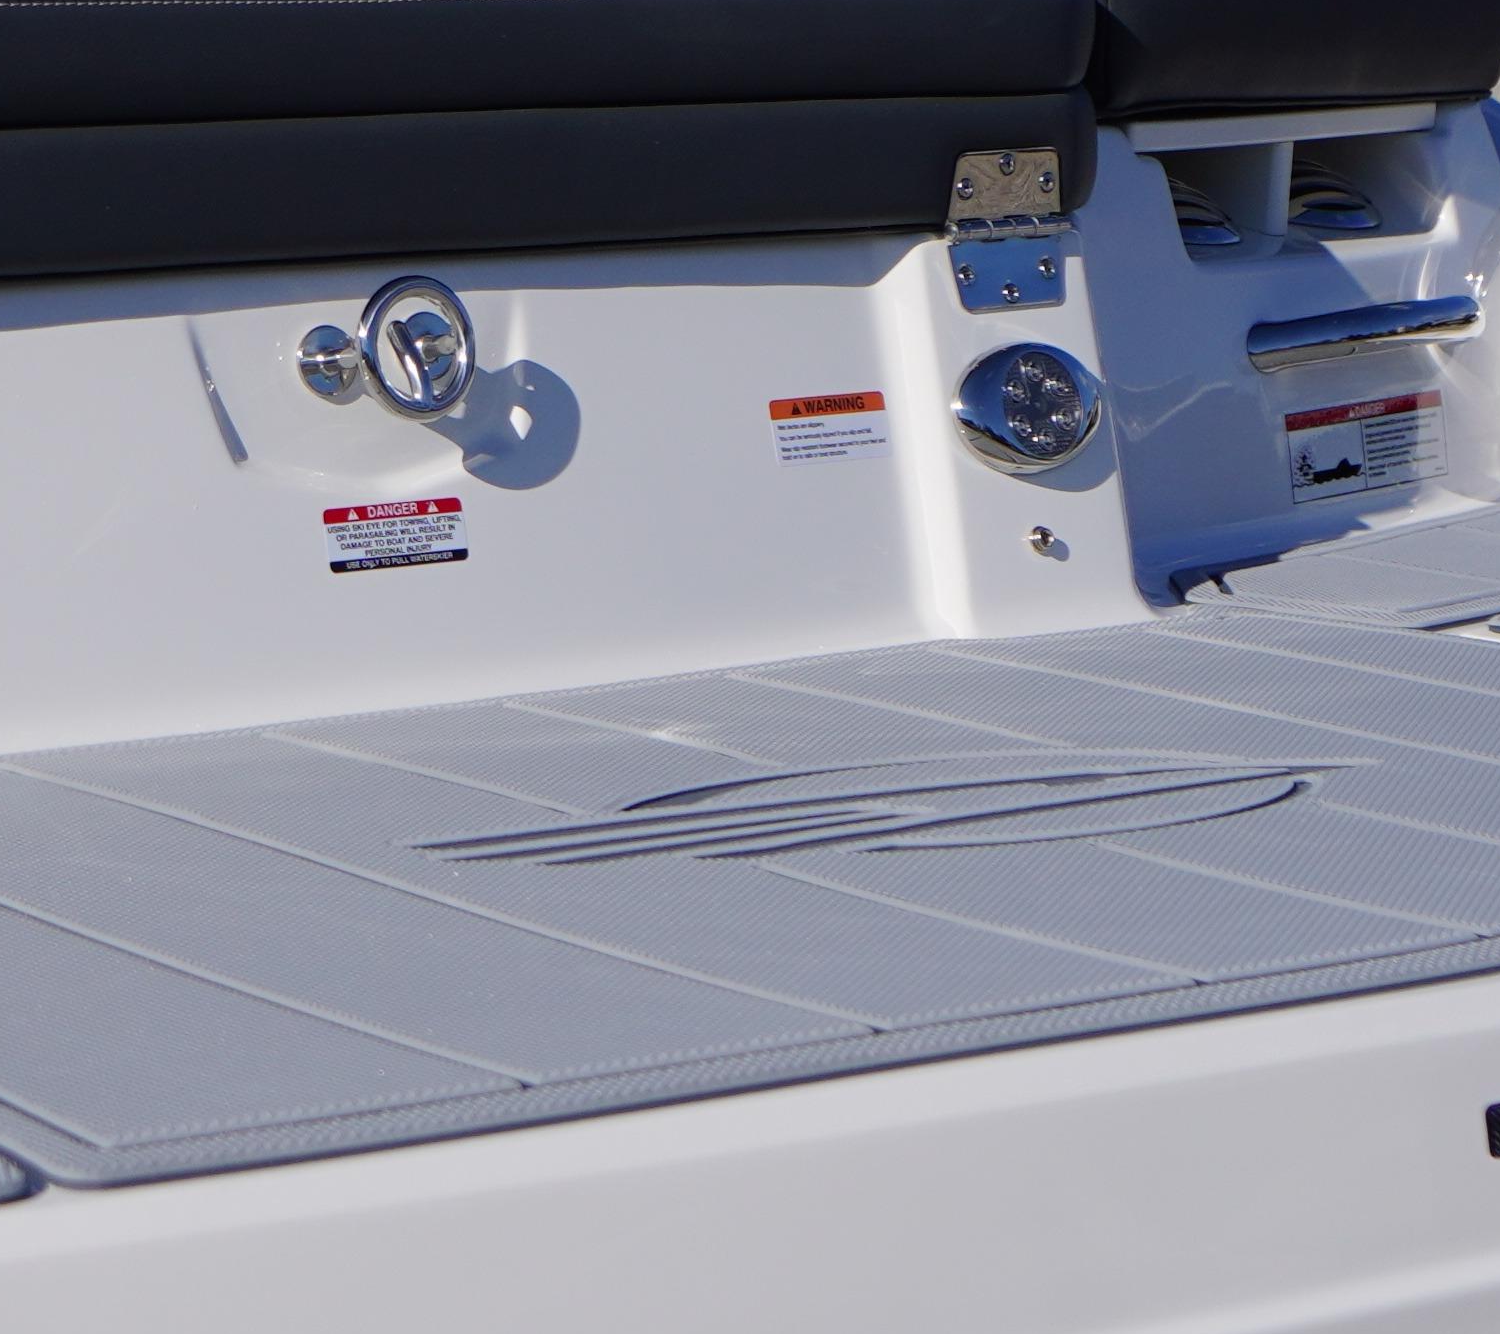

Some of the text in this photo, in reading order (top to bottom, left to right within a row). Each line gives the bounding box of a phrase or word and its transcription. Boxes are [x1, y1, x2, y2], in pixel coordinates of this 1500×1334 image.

[803, 396, 865, 413] WARNING
[367, 502, 419, 517] DANGER
[366, 522, 381, 530] EYE
[383, 520, 398, 529] FOR
[400, 526, 416, 535] WILL
[419, 524, 446, 534] RESULT
[341, 533, 453, 551] DAMAGE TO BOAT AND SEVERE
[365, 544, 432, 557] PERSONAL INJURY
